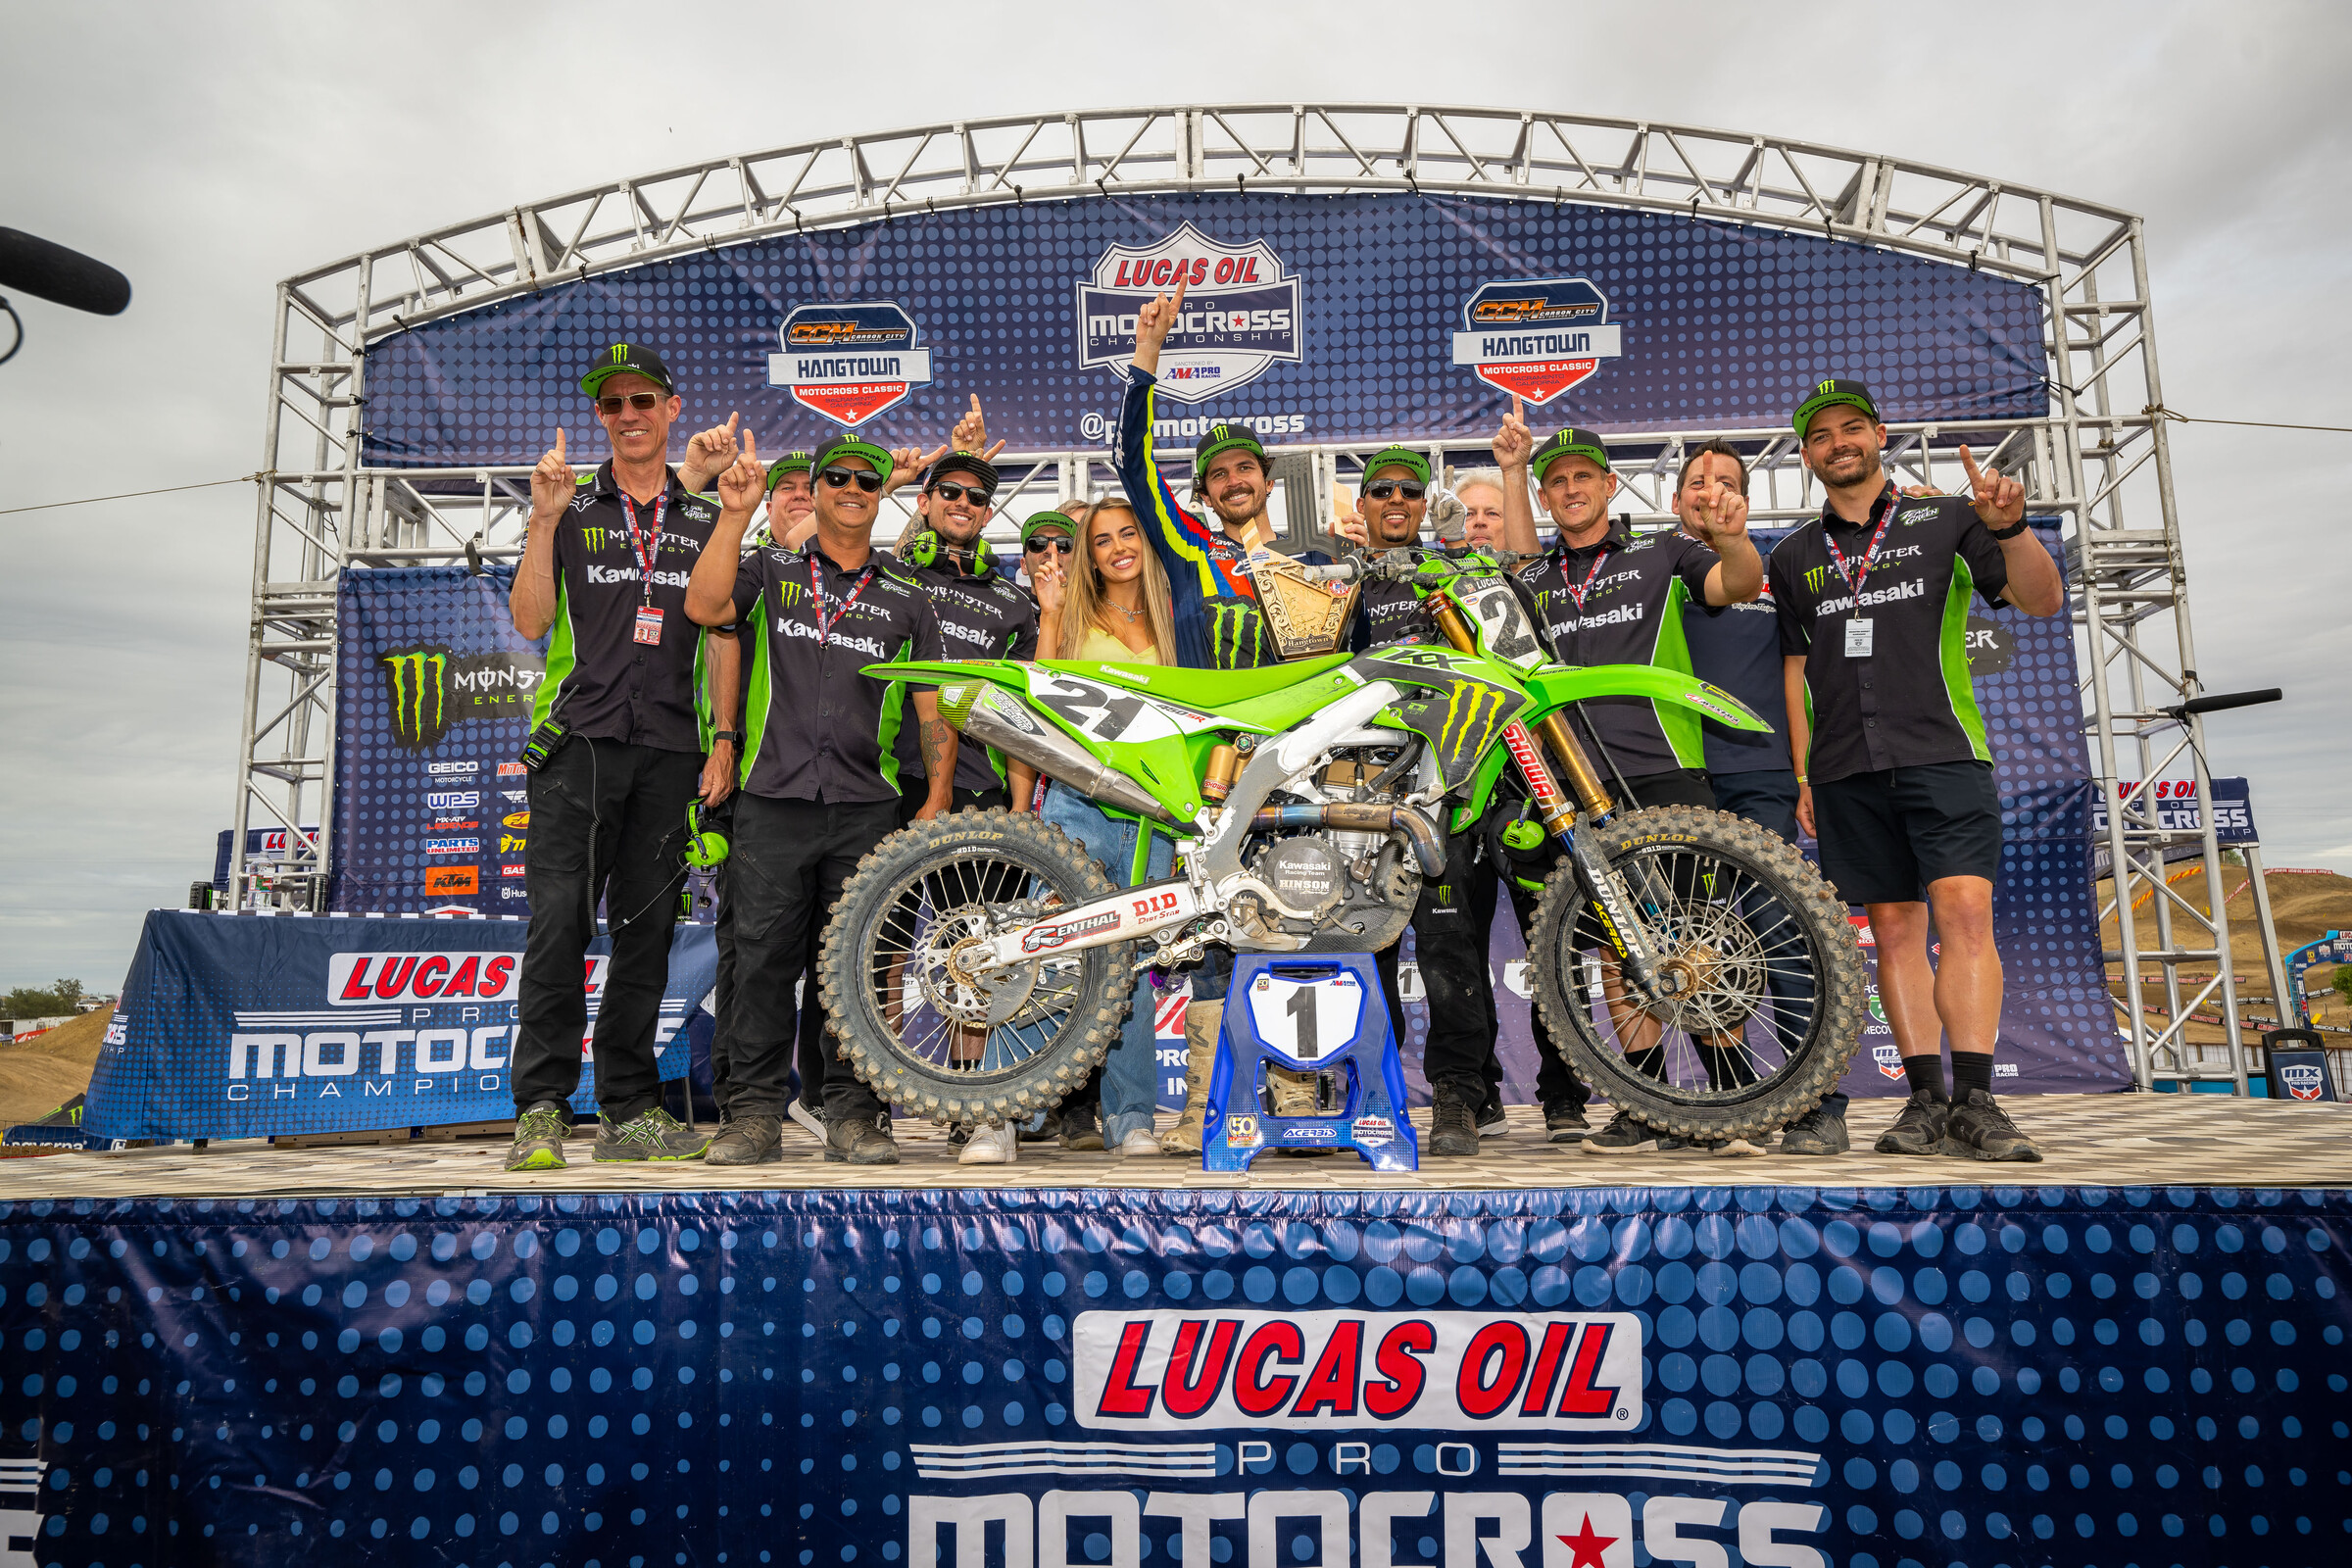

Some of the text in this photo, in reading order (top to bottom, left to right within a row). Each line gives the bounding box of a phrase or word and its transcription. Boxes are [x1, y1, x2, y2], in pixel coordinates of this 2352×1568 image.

[1114, 257, 1259, 287] LUCAS OIL
[1184, 301, 1215, 311] RO
[1089, 309, 1291, 336] MOOCROSS
[1090, 331, 1292, 347] CHAPIONSHIP
[1482, 332, 1591, 358] HANGTOWN
[798, 358, 901, 378] HANGTOWN
[1163, 368, 1200, 380] AMA
[1483, 362, 1592, 375] MOTOCROSS CLASSIC
[799, 385, 903, 396] MOTOCROSS CLASSIC
[1799, 396, 1858, 418] Kawasaki
[832, 450, 887, 465] Kawasaki
[1203, 441, 1252, 461] Kawasaki
[1541, 447, 1595, 464] Kawasaki
[1374, 458, 1424, 469] Kawasaki
[1028, 516, 1074, 530] Kawasaki
[1207, 549, 1232, 561] Airoh
[1867, 543, 1880, 560] 2022
[1367, 600, 1418, 617] NSTER
[1479, 590, 1539, 661] 2
[1542, 602, 1643, 642] awasaki
[776, 617, 886, 660] Kawasaki
[1288, 636, 1330, 647] Hangtown
[1493, 654, 1526, 673] Kawasaki
[1099, 663, 1152, 684] Kawasaki
[1035, 679, 1146, 742] 21
[427, 761, 479, 774] GEICO
[1502, 723, 1556, 800] SHOWA
[1204, 781, 1227, 791] SHOWA
[428, 792, 479, 809] WPS
[426, 821, 479, 831] LEGENDS
[427, 838, 479, 848] PARTS
[928, 830, 1004, 850] DUNLOP
[1620, 833, 1699, 851] DUNLOP
[1279, 860, 1331, 871] Kawasaki
[433, 873, 471, 888] KTM
[1279, 879, 1331, 890] HINSON
[1133, 892, 1178, 917] D.I.D
[1588, 867, 1645, 959] DUNLOP
[1592, 900, 1628, 959] ACERBIS
[340, 955, 516, 1002] LUCAS
[1287, 986, 1318, 1058] 1
[1995, 1063, 2019, 1073] PRO
[2284, 1068, 2320, 1078] MX
[1230, 1116, 1253, 1135] 50
[1283, 1128, 1337, 1138] ACERBIS
[1095, 1319, 1621, 1421] LUCAS OIL
[1240, 1441, 1477, 1477] PRO
[908, 1490, 1827, 1568] MOTOCROSS
